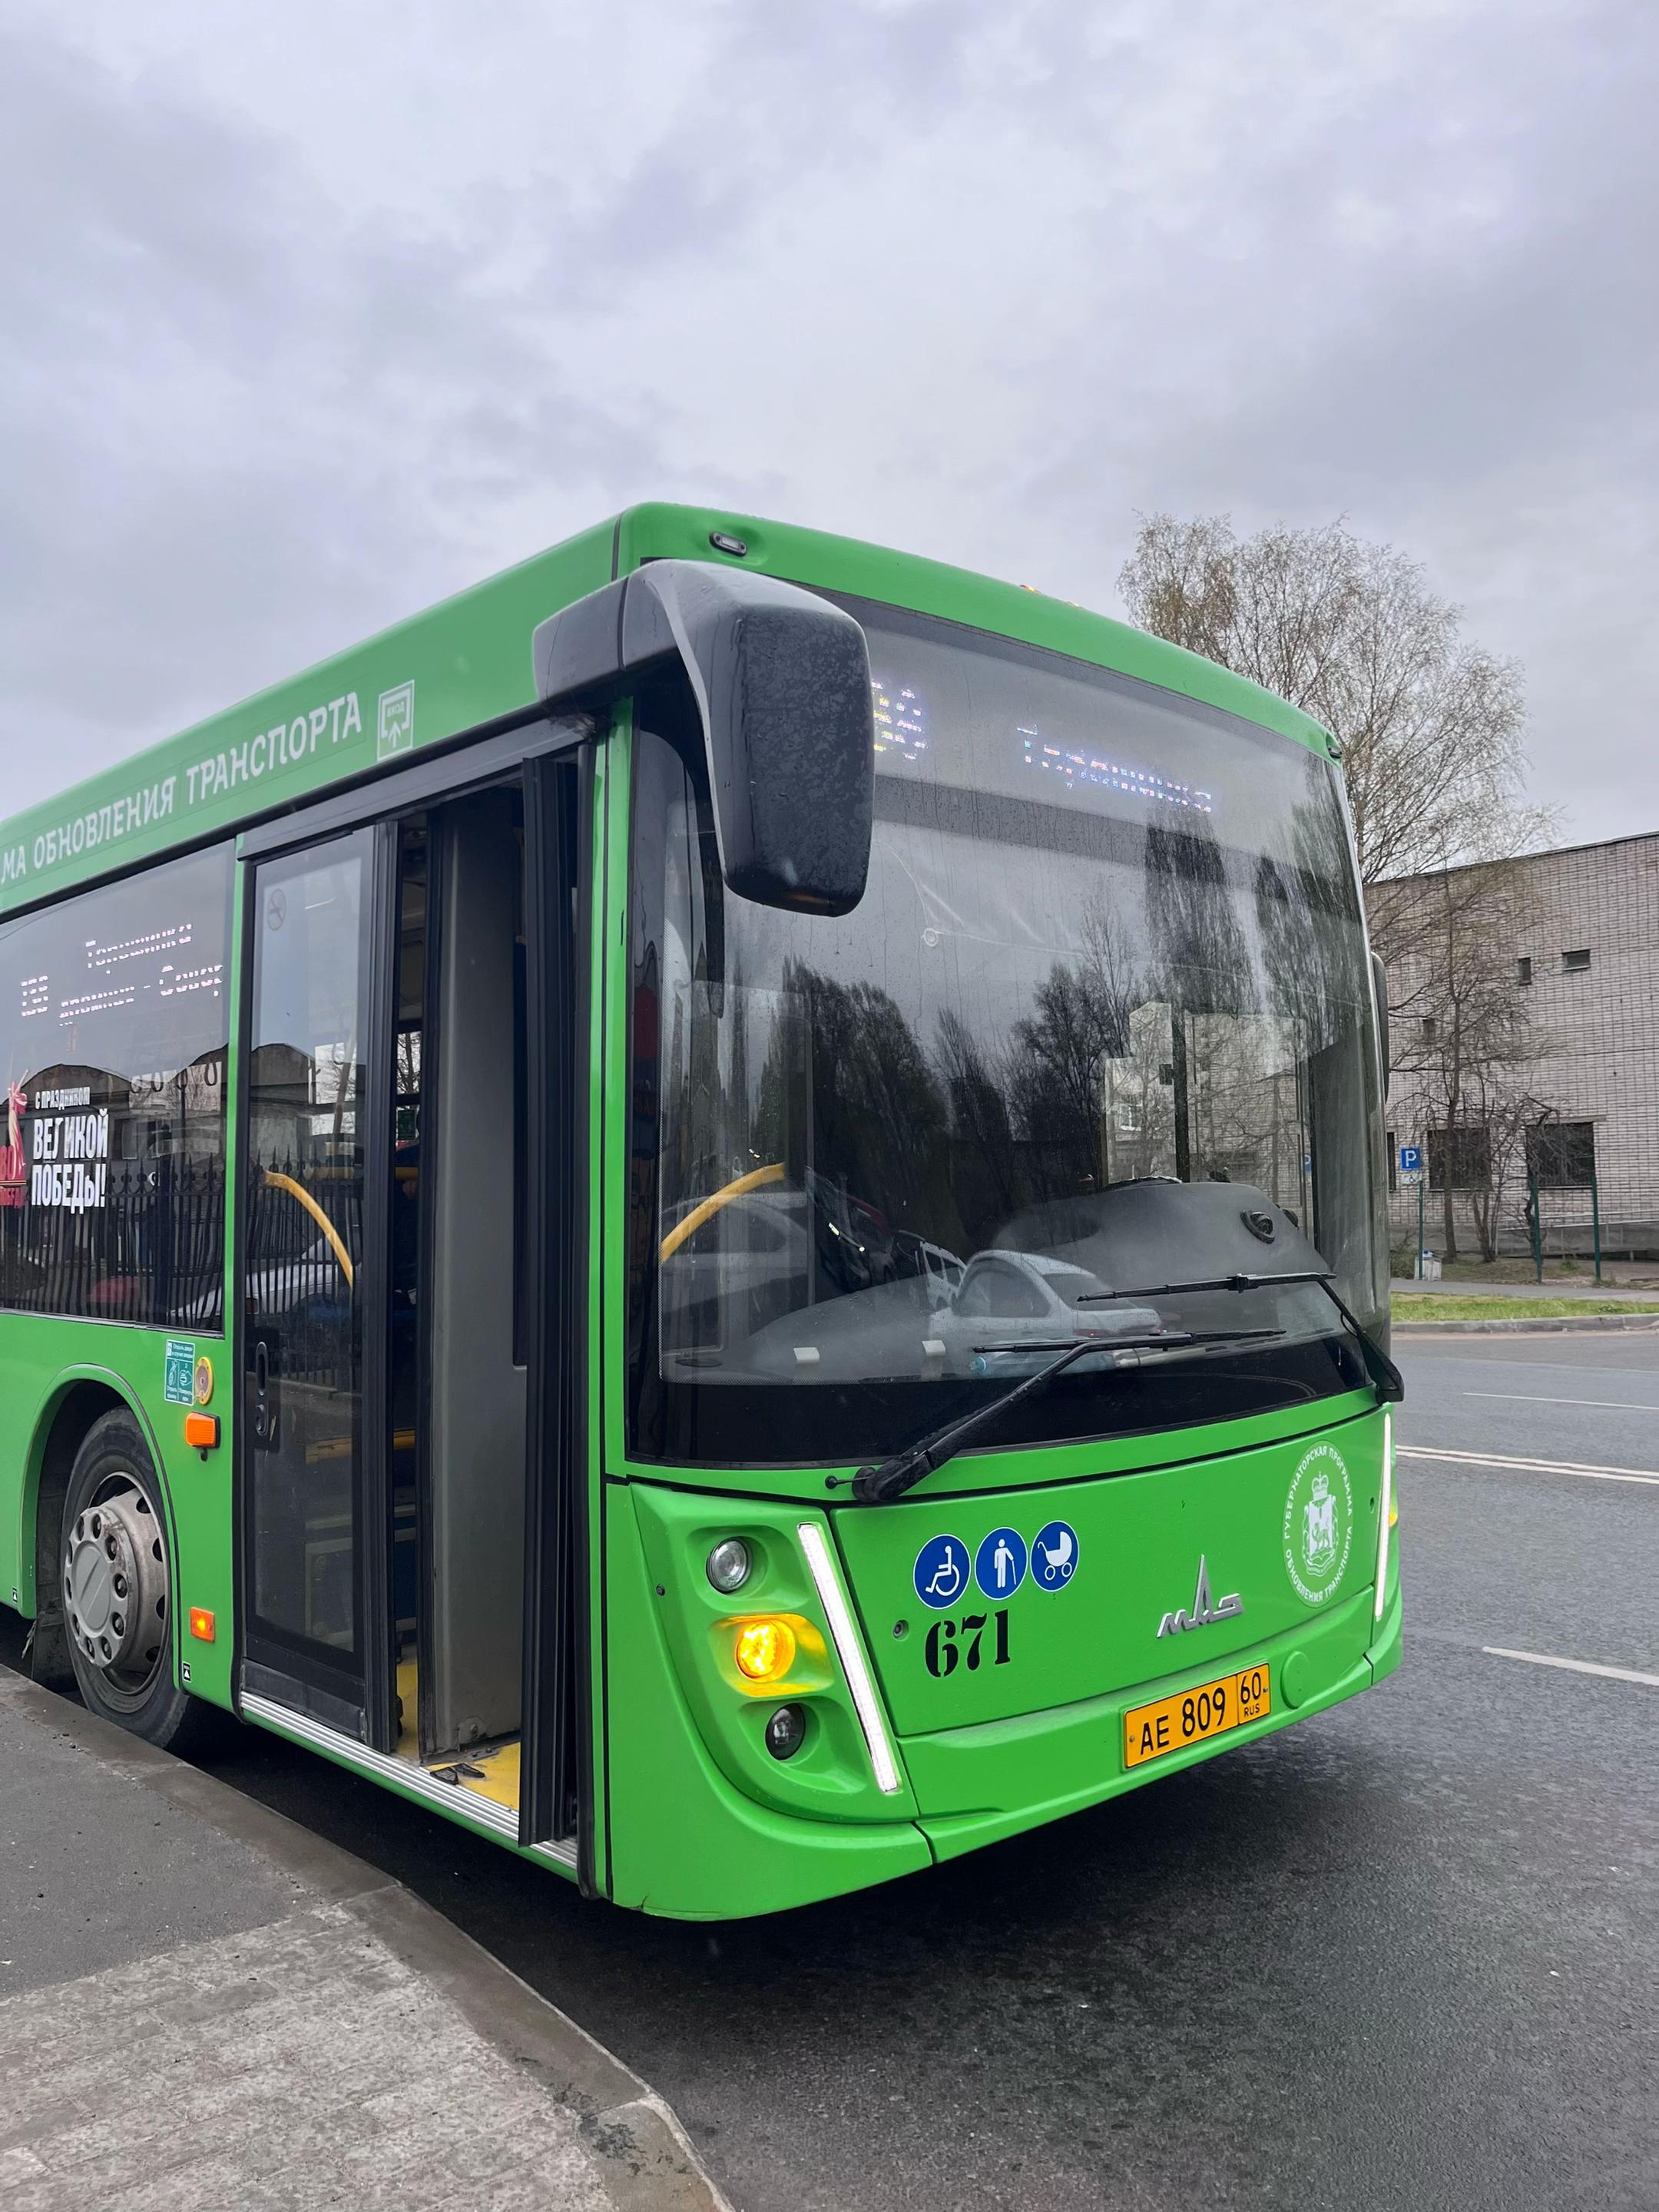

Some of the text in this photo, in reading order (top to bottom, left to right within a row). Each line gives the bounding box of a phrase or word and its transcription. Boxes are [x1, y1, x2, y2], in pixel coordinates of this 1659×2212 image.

[33, 776, 177, 869] ОБНОВЛЕНИЯ
[187, 692, 362, 805] ТРАНСПОРТА
[35, 1087, 91, 1110] С ПРАЗДНИКОМ
[31, 1163, 107, 1214] ПОБЕДЫ!
[1405, 1150, 1417, 1167] P
[1284, 1445, 1353, 1539] ГУБЕРНАТОРСКАЯ ПРОГРАММА
[1286, 1526, 1353, 1602] ОБНОВЛЕНИЯ ТРАНСПОРТА
[926, 1609, 1011, 1677] 671
[1182, 1687, 1226, 1737] 809
[1240, 1672, 1261, 1704] 60
[1243, 1703, 1260, 1717] RUS
